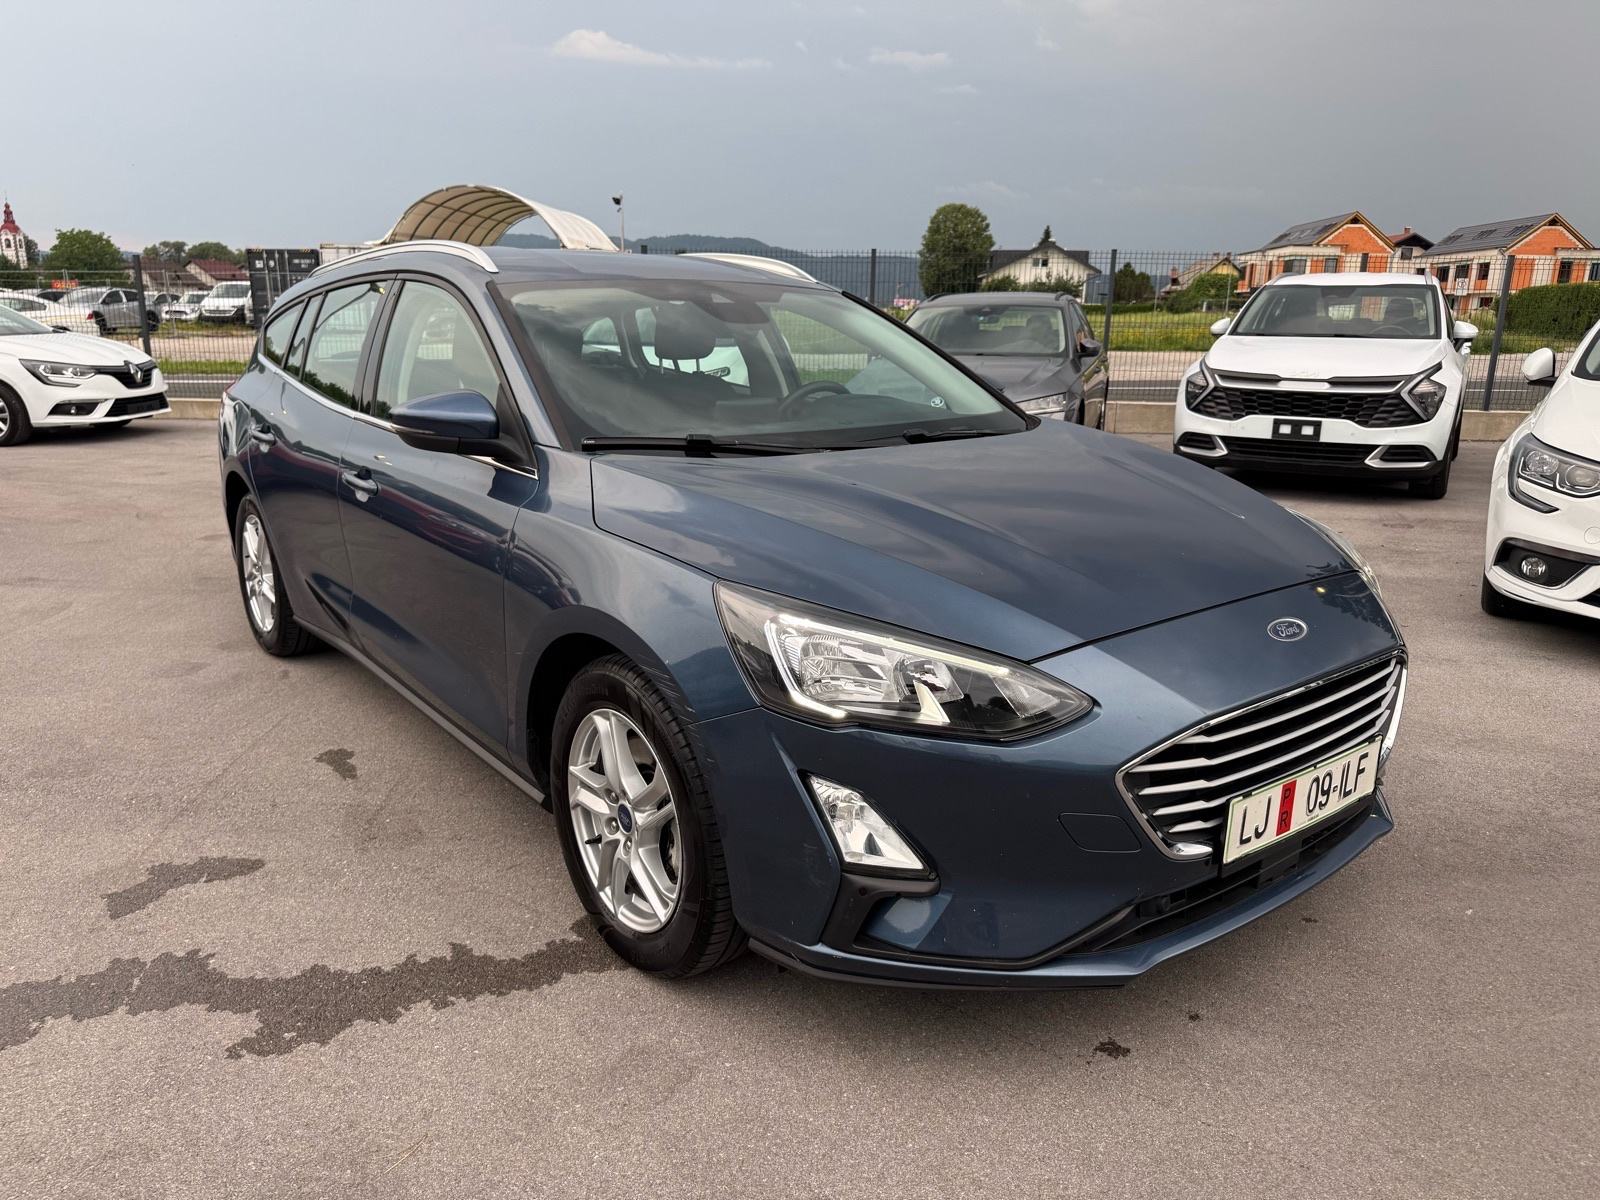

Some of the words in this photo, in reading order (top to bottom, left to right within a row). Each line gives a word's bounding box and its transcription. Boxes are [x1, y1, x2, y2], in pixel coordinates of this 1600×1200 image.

[1276, 622, 1300, 637] Ford
[1239, 795, 1272, 845] LJ
[1306, 752, 1369, 816] 09-ILF
